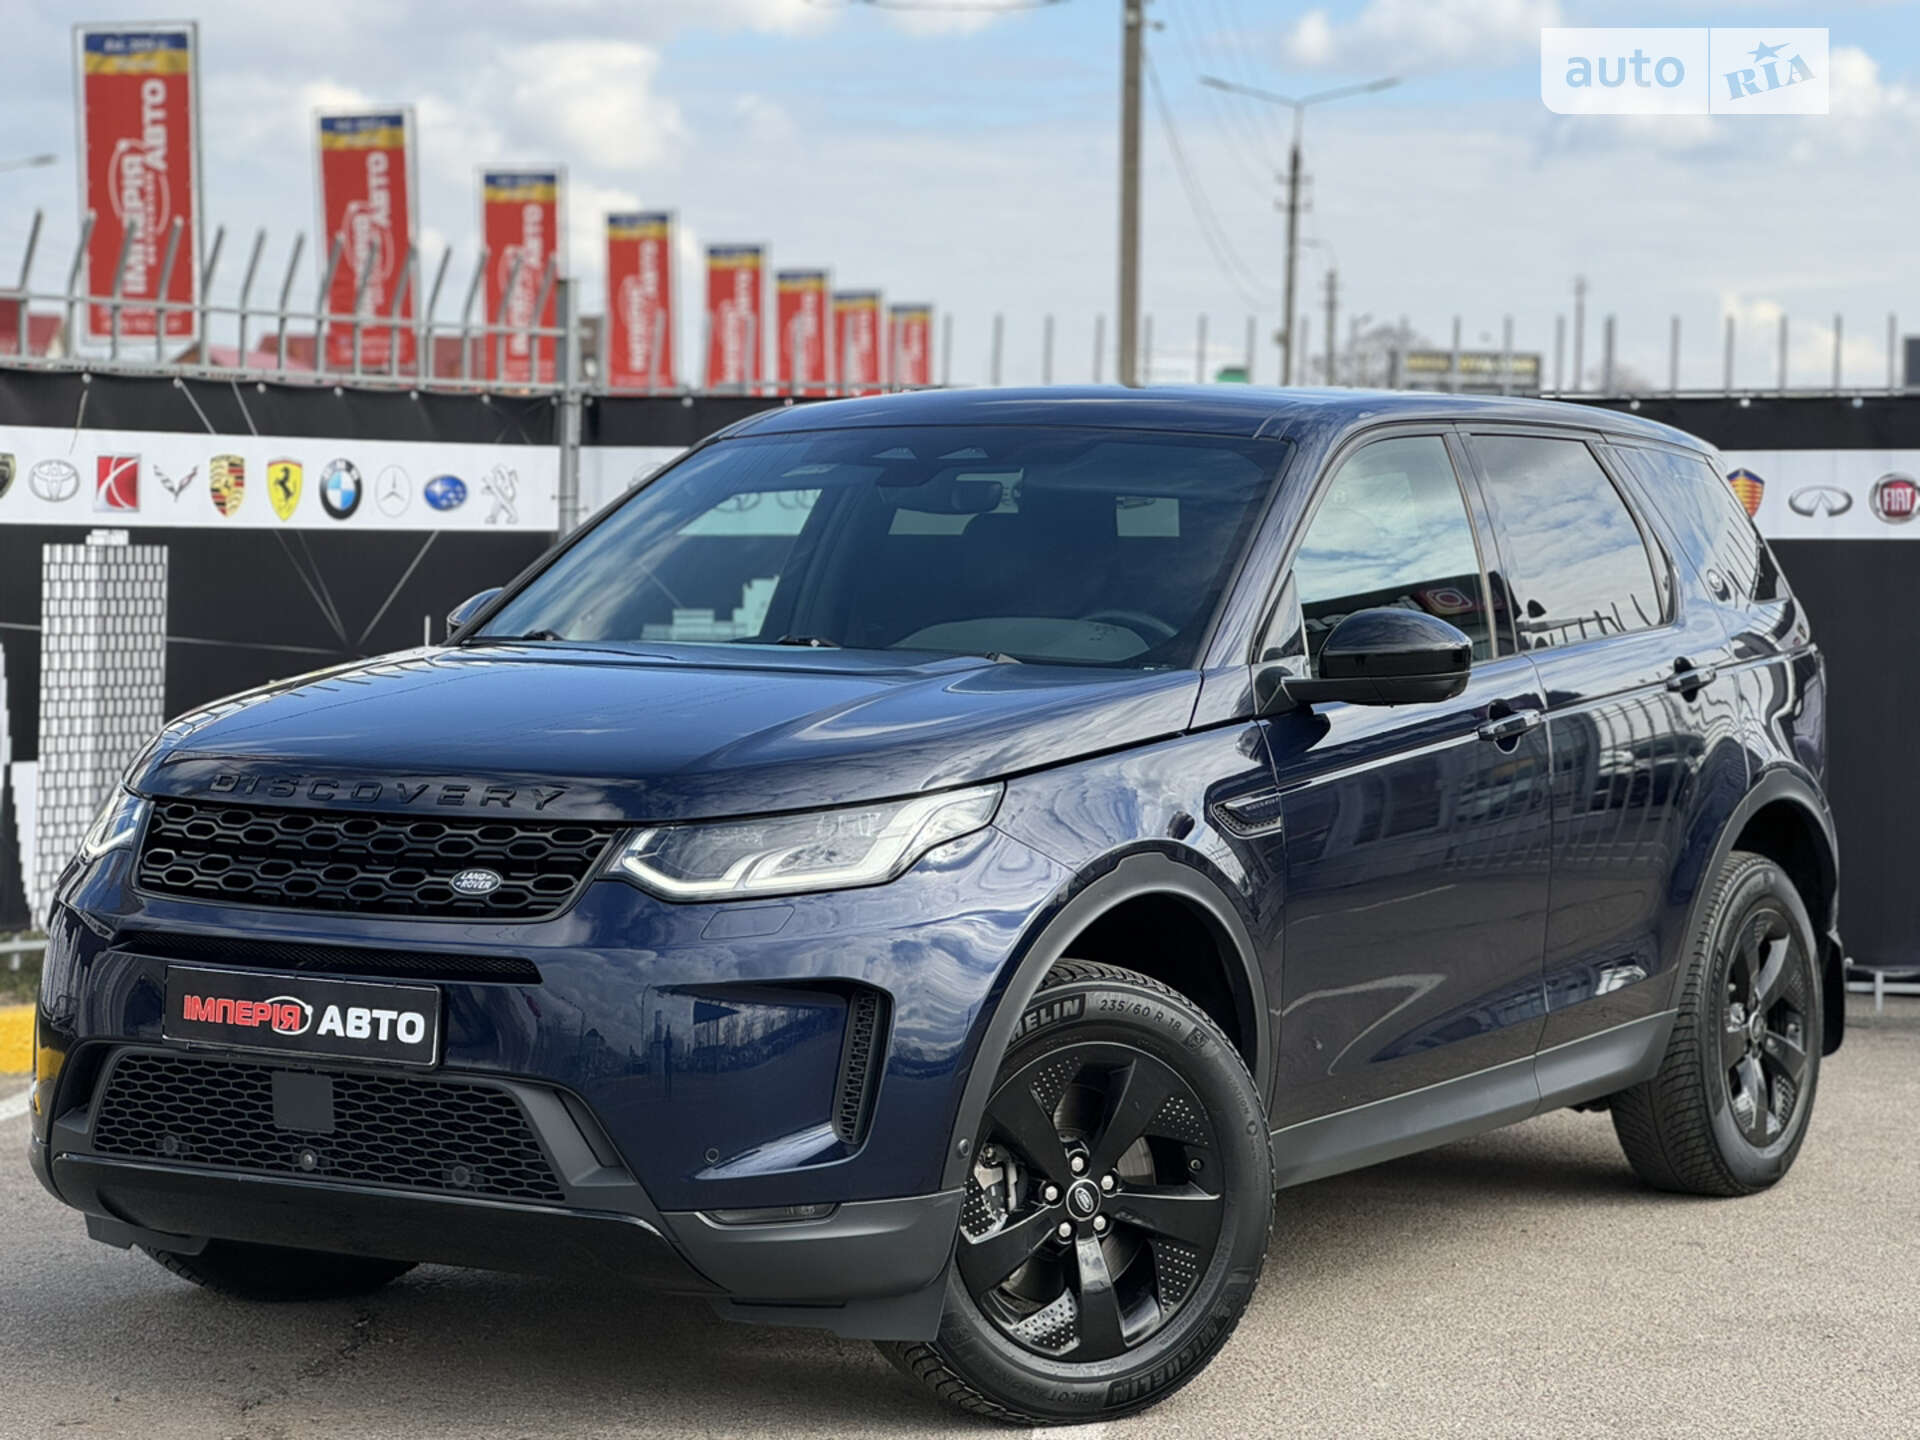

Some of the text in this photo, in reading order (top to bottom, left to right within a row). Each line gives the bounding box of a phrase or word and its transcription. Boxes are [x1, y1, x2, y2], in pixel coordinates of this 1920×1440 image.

[142, 78, 168, 172] АВТО
[1882, 487, 1913, 512] FIAT
[209, 773, 572, 811] DISCOVERY
[183, 995, 426, 1044] ІМПЕРІЯ АВТО
[1099, 999, 1183, 1032] 235/60 R 18
